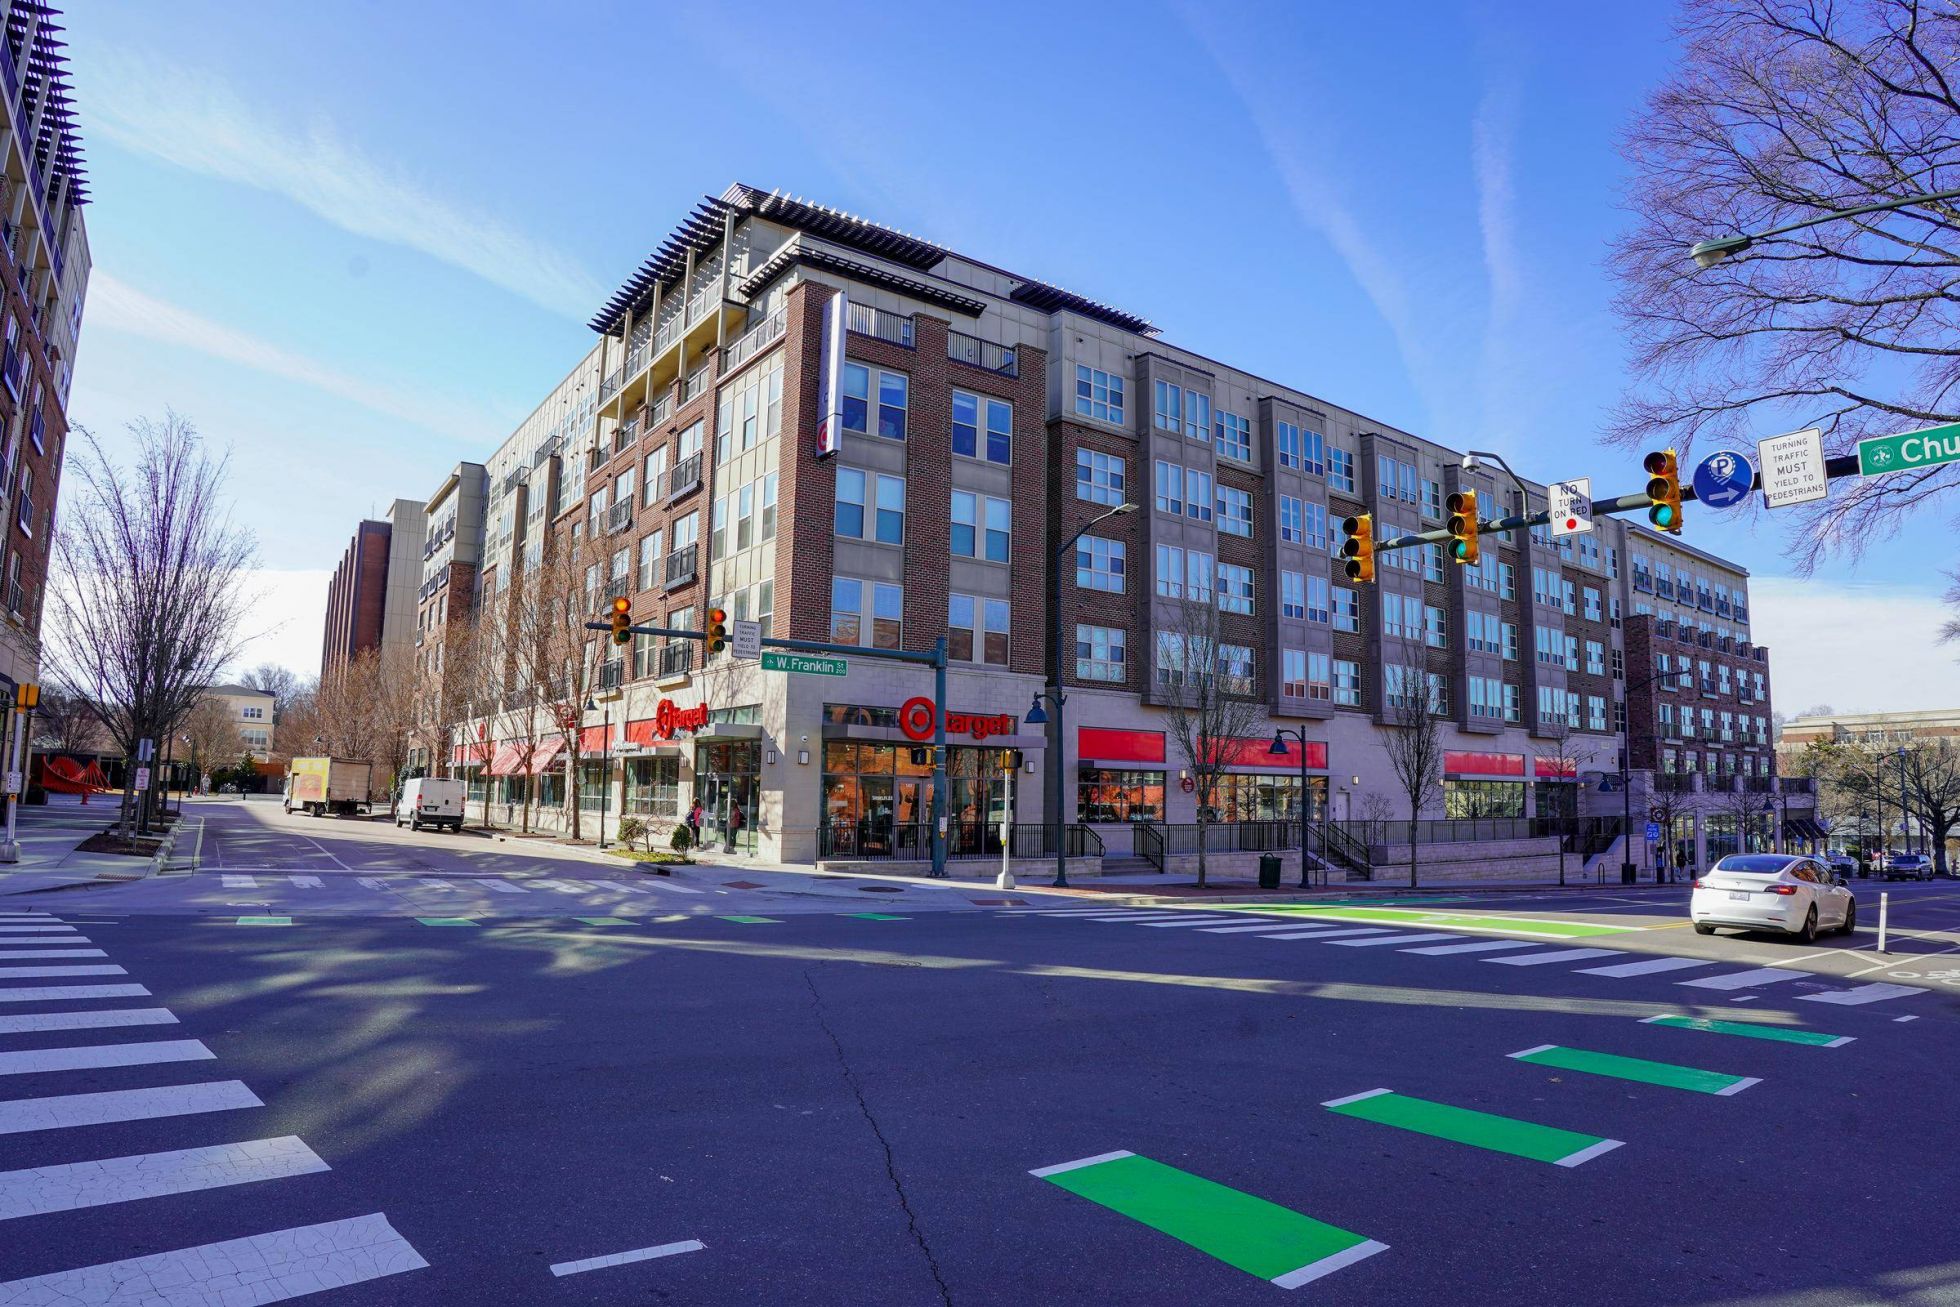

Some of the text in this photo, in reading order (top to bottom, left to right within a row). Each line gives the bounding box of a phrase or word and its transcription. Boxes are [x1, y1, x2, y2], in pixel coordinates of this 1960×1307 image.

[1772, 438, 1808, 451] TURNING
[1773, 450, 1808, 463] TRAFFIC
[1717, 459, 1728, 475] P
[1777, 462, 1807, 476] MUST
[1775, 474, 1814, 488] YIELD TO
[1561, 484, 1578, 496] NO
[1767, 484, 1824, 501] PEDESTRIANS
[1559, 496, 1582, 507] TURN
[1554, 506, 1588, 519] ON RED
[791, 657, 834, 673] Franklin
[945, 710, 1009, 740] target
